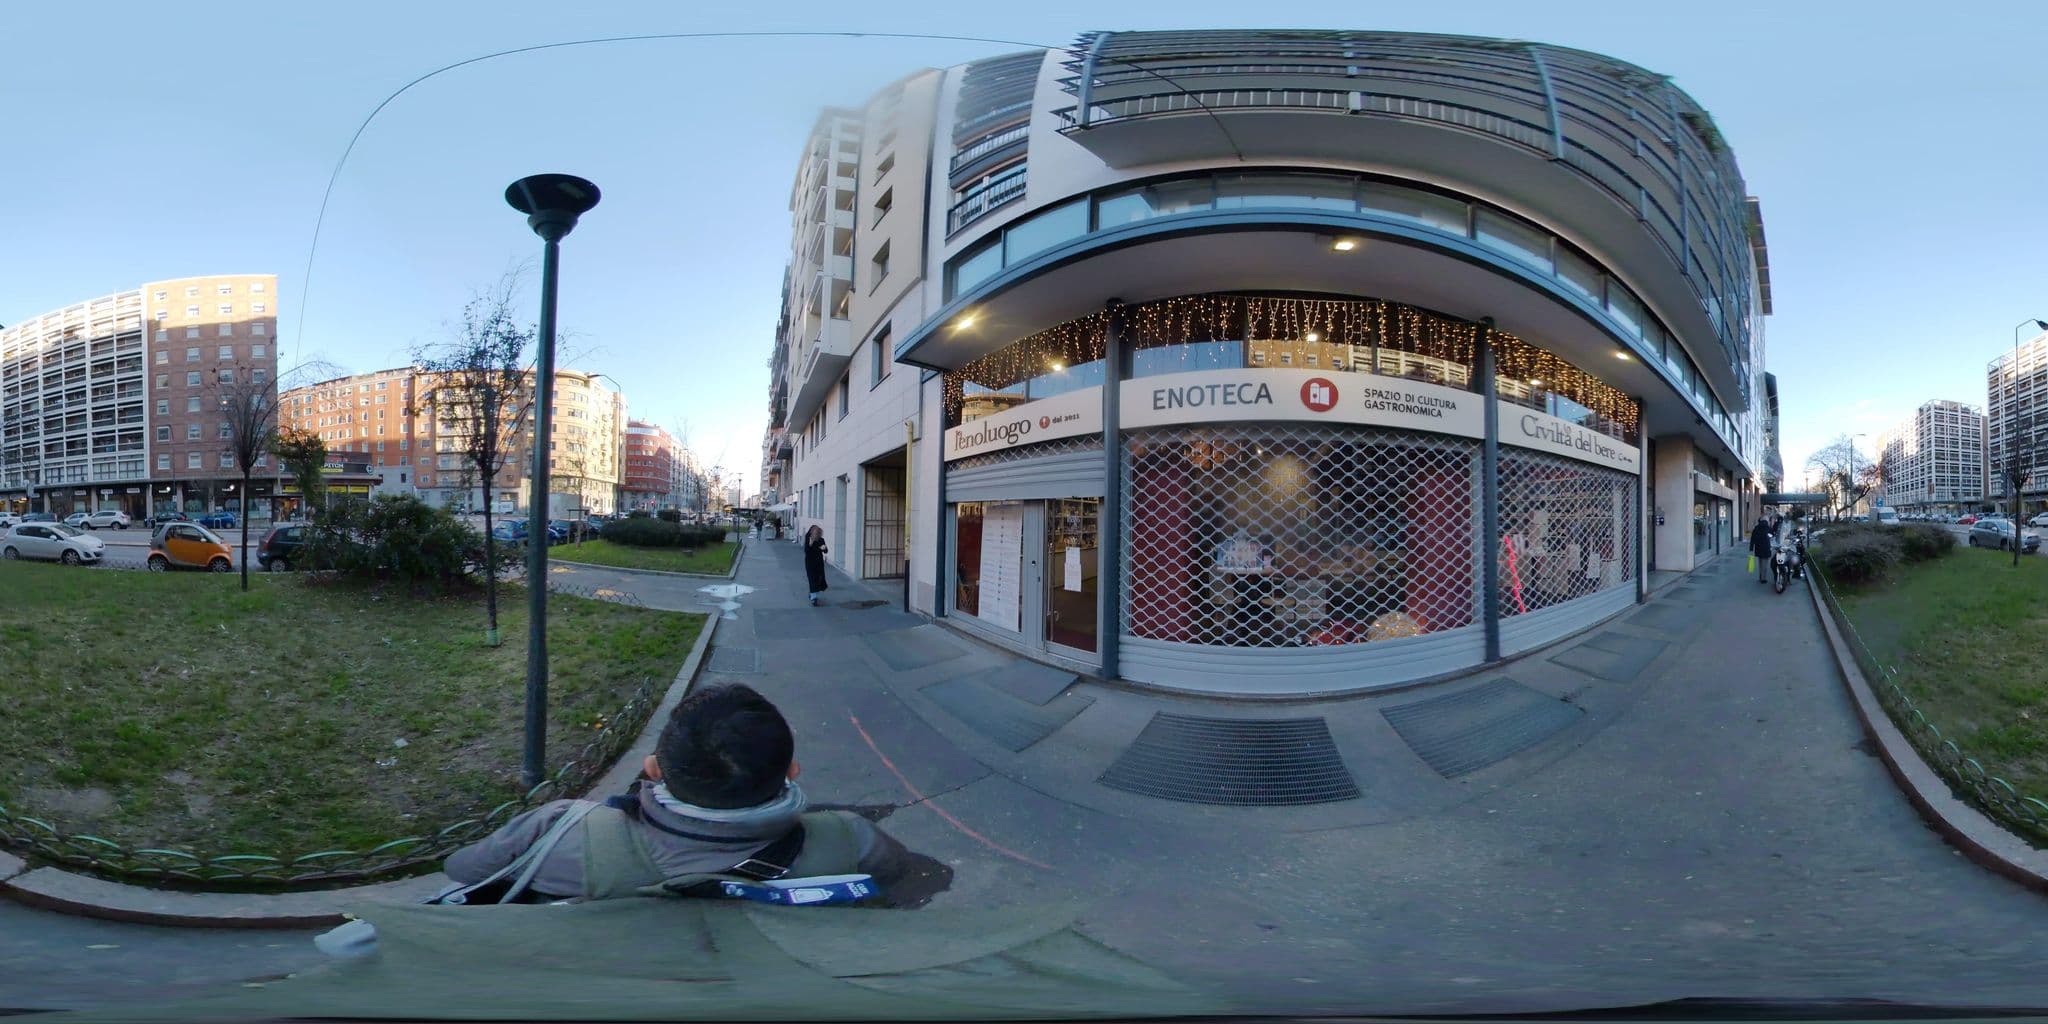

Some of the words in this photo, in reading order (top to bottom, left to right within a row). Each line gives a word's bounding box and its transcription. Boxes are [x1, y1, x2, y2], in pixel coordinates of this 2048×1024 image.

[1152, 382, 1273, 410] ENOTECA
[1364, 388, 1401, 401] SPAZIO
[1405, 393, 1415, 403] DI
[1417, 395, 1457, 410] CULTURA
[1052, 416, 1063, 424] dal
[1364, 400, 1443, 418] GASTRONOMICA
[1521, 414, 1573, 447] Civiltà
[1575, 431, 1592, 453] del
[1593, 435, 1616, 459] bere
